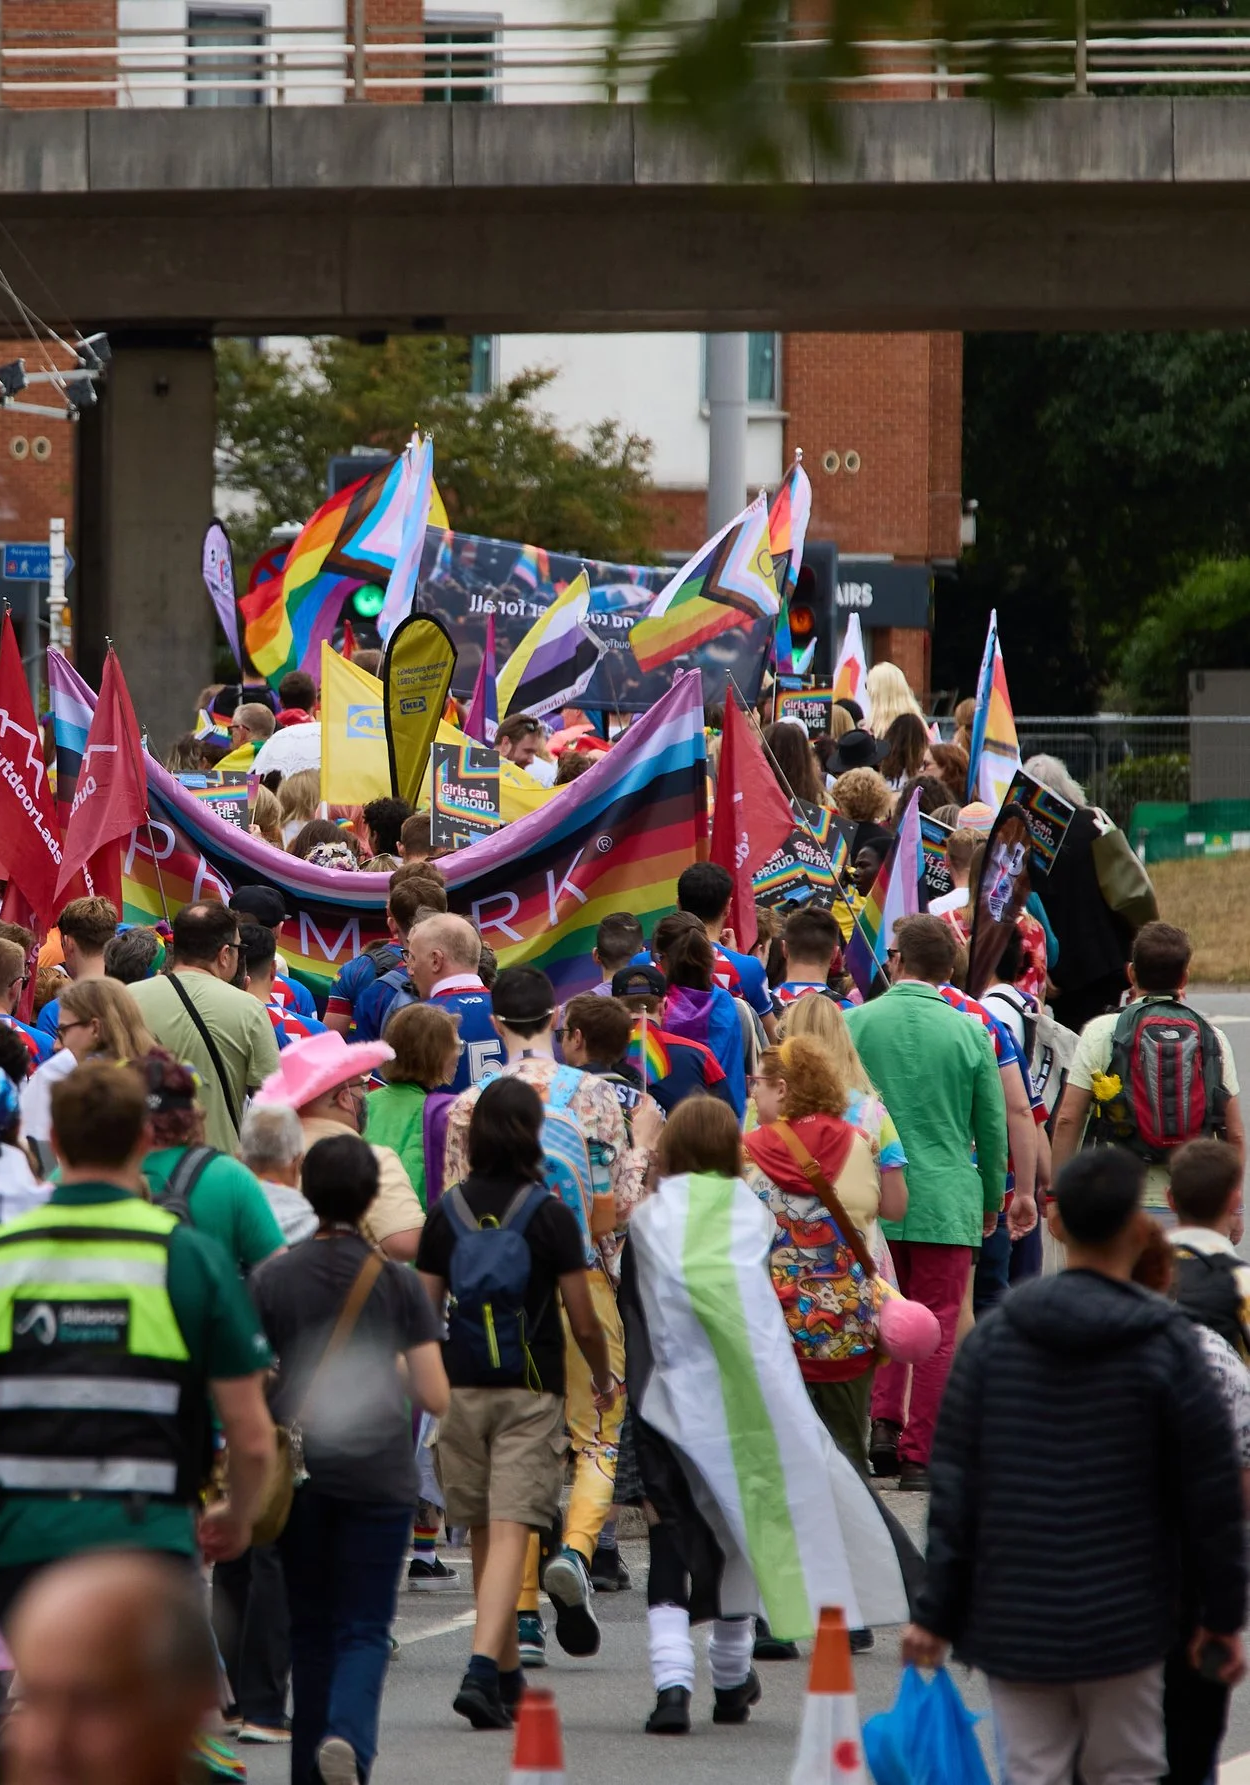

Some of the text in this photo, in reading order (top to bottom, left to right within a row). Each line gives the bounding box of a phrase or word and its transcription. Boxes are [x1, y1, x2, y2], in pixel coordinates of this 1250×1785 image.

[402, 700, 424, 711] IKEA
[783, 699, 825, 711] Girls can
[803, 708, 822, 718] THE
[805, 718, 826, 729] NGE
[441, 782, 490, 801] Girls can
[215, 802, 238, 811] can
[438, 792, 496, 812] BE PROUD
[1035, 819, 1052, 836] can
[795, 840, 815, 855] Girls
[756, 854, 795, 881] PROUD
[927, 864, 949, 880] THE
[925, 874, 951, 892] NGE
